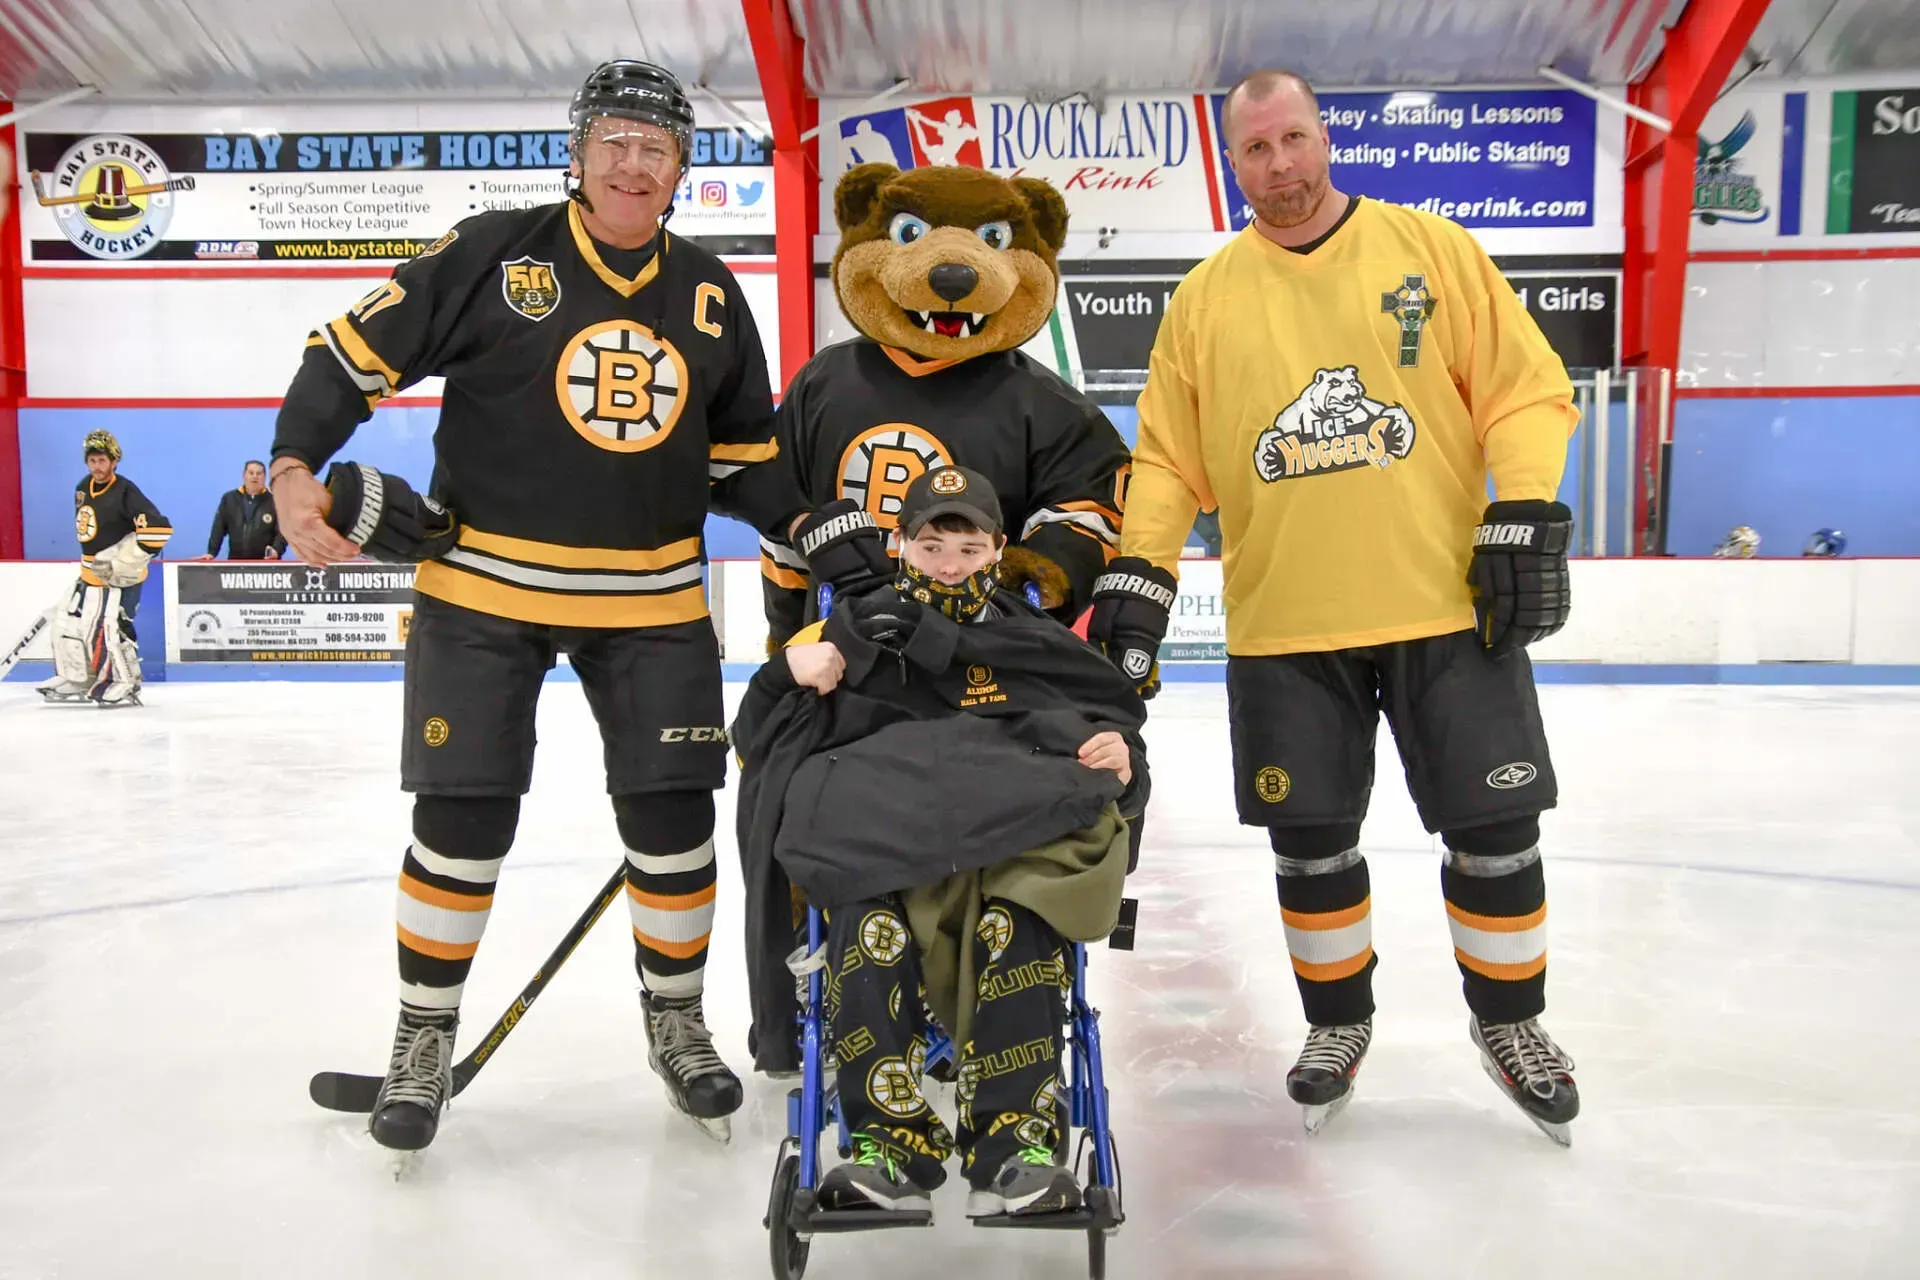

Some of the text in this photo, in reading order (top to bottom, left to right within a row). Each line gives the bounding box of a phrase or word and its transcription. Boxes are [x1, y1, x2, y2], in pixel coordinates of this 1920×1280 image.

[1322, 103, 1564, 128] ckey Skating Lessons
[990, 99, 1189, 169] ROCKLAND
[205, 136, 282, 169] BAY
[298, 136, 426, 169] STATE
[440, 134, 570, 168] HOCKE
[1329, 141, 1571, 168] kating Public Skating
[60, 140, 158, 188] BAY STATE
[258, 181, 424, 198] Spring/Summer League
[481, 181, 571, 194] Tournamen
[1064, 166, 1164, 190] Rink
[258, 200, 431, 216] Full Season Competitive
[258, 216, 409, 232] Town Hockey League
[80, 224, 155, 253] HOCKEY
[506, 265, 553, 292] 50
[694, 282, 726, 338] C
[1075, 292, 1153, 315] Youth
[1538, 287, 1606, 311] Girls
[597, 348, 656, 423] B
[1313, 415, 1347, 439] ICE
[1274, 416, 1392, 477] HUGGERS
[220, 573, 416, 589] WARWICK INDUSTRIA
[285, 593, 357, 602] FASTENERS
[326, 612, 385, 623] 401-739-9200
[325, 632, 387, 643] 508-594-3300
[252, 650, 391, 661] www.warwickfasteners.com
